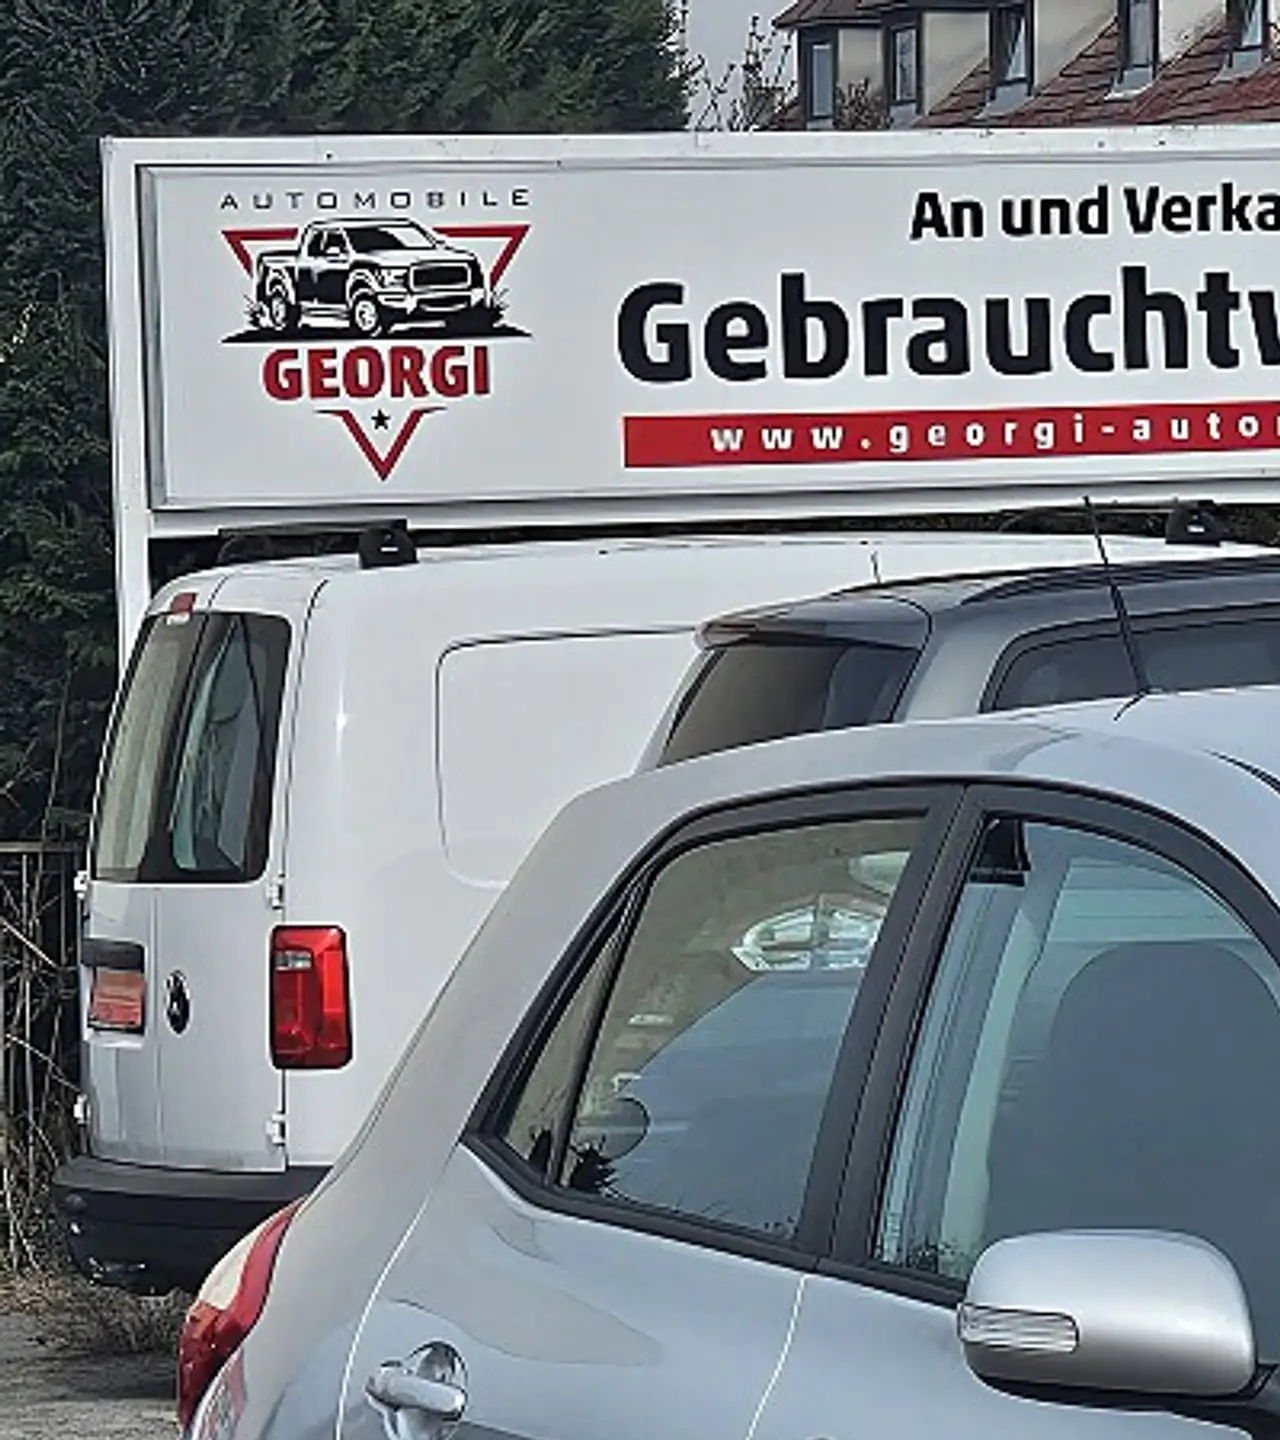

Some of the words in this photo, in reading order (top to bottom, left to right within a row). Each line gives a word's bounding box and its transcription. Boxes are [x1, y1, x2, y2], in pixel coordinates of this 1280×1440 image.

[220, 188, 531, 209] AUTOMOBILE
[911, 192, 983, 239] An
[1002, 186, 1109, 236] und
[262, 345, 491, 400] GEORGI
